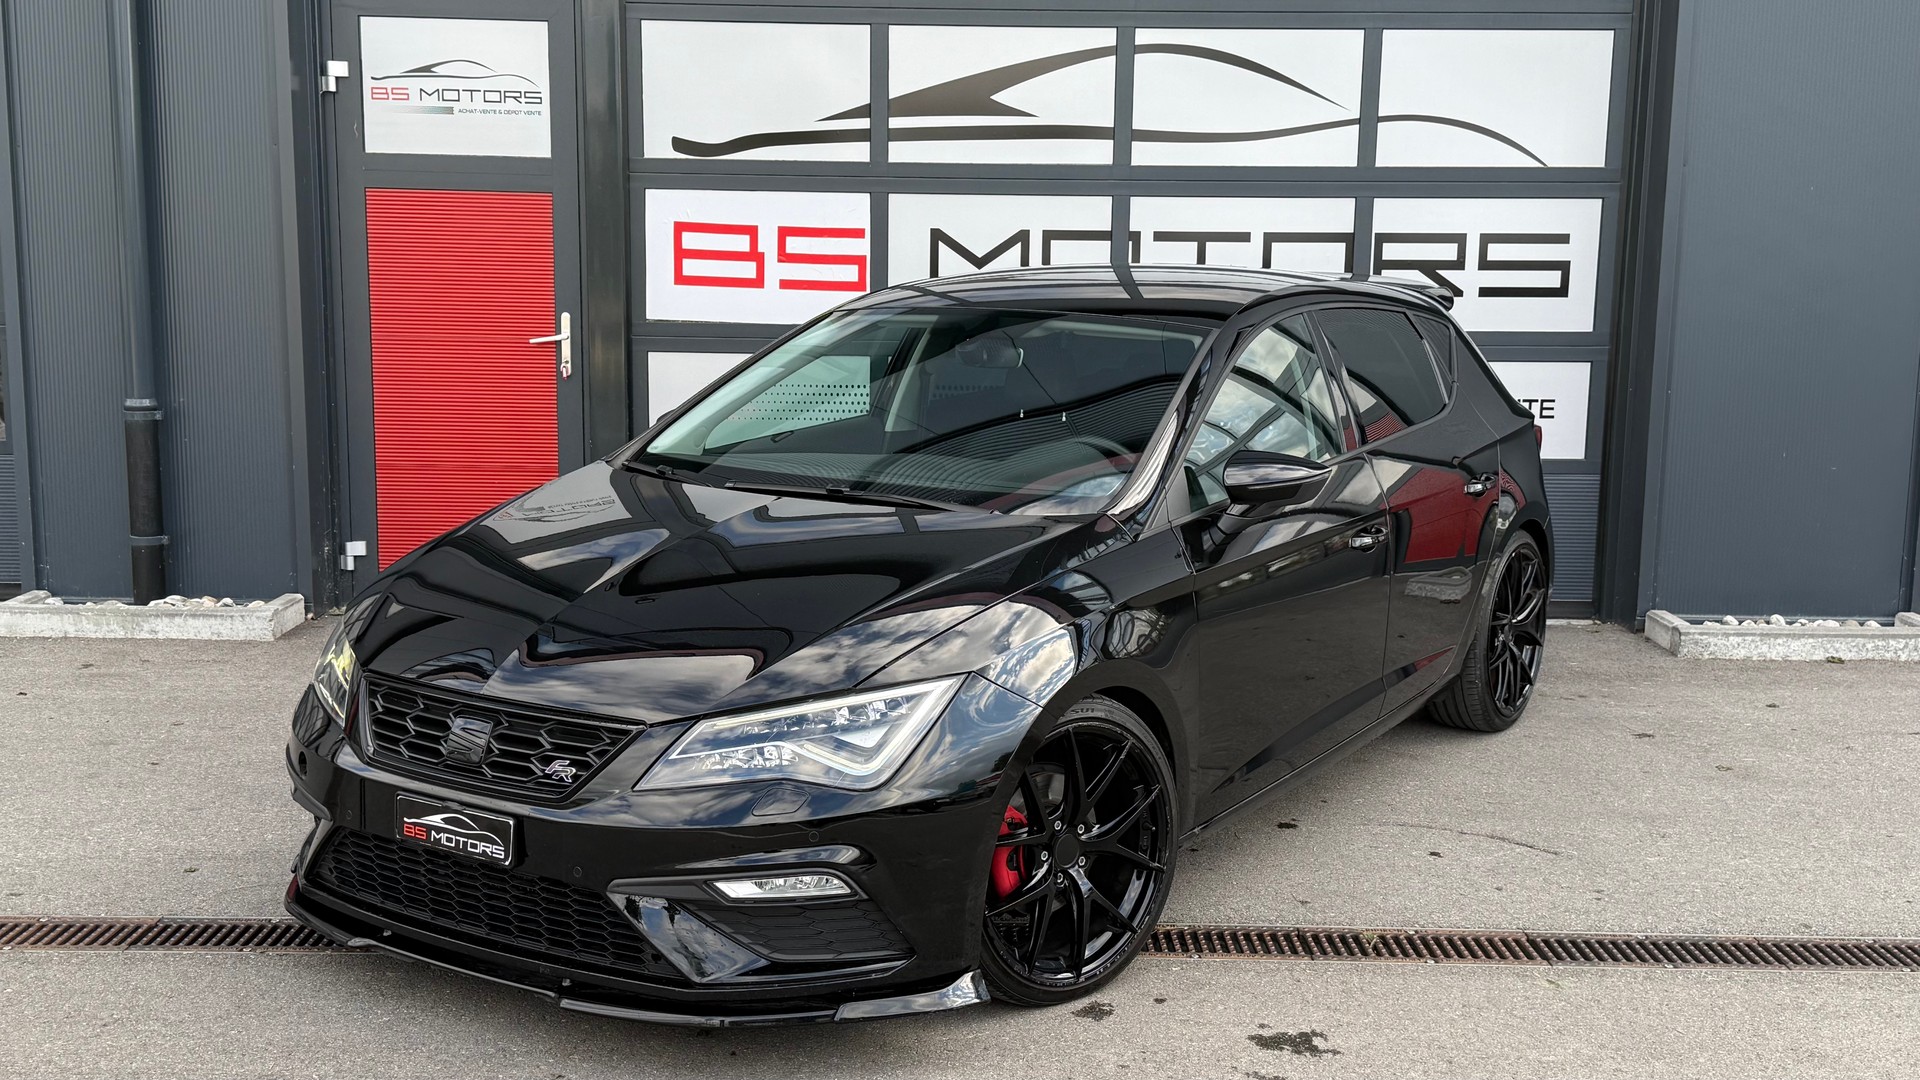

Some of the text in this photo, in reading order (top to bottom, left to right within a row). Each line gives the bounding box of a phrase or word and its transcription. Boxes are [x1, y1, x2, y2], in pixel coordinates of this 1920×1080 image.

[371, 87, 543, 102] BS MOTORS
[673, 221, 867, 291] BS
[545, 760, 577, 782] FR
[403, 823, 505, 859] BS MOTORS
